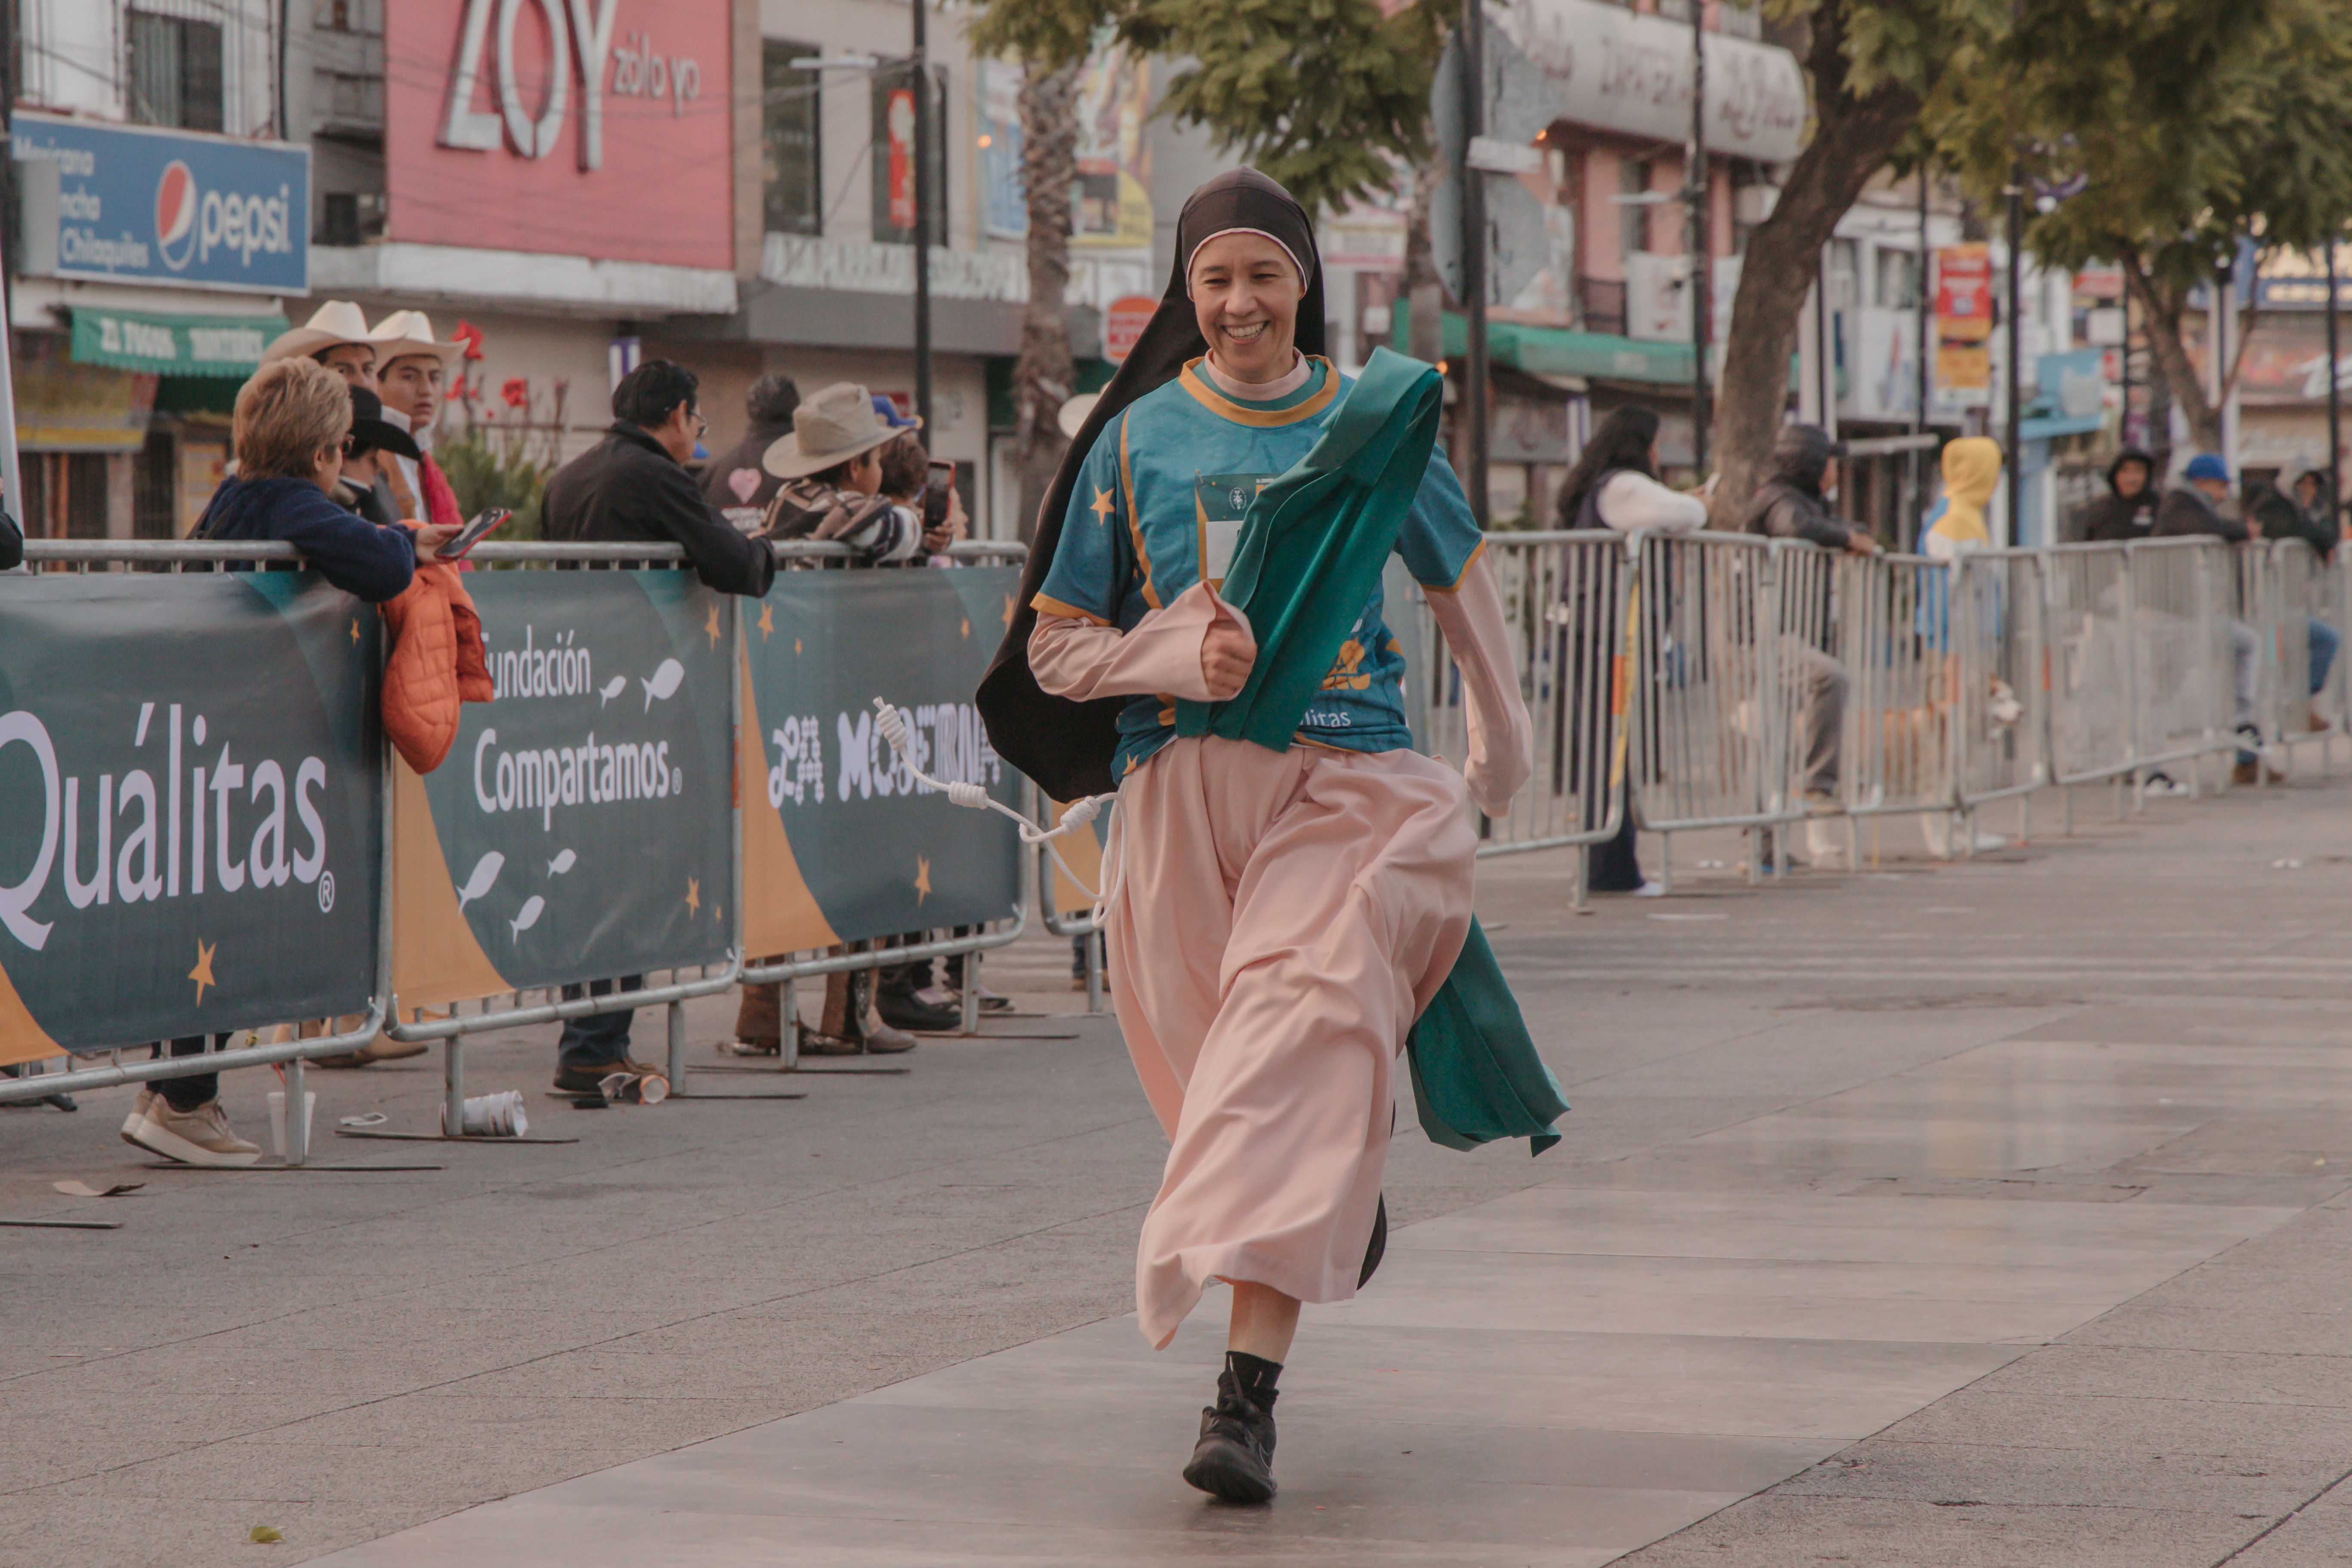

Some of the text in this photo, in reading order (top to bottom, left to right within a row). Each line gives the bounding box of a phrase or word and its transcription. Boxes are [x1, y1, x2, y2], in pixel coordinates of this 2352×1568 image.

[200, 182, 289, 268] pepsi
[480, 624, 591, 700] undación
[769, 715, 824, 809] LA
[1299, 709, 1352, 727] litas
[474, 728, 670, 832] Compartamos
[0, 702, 326, 951] Quálitas
